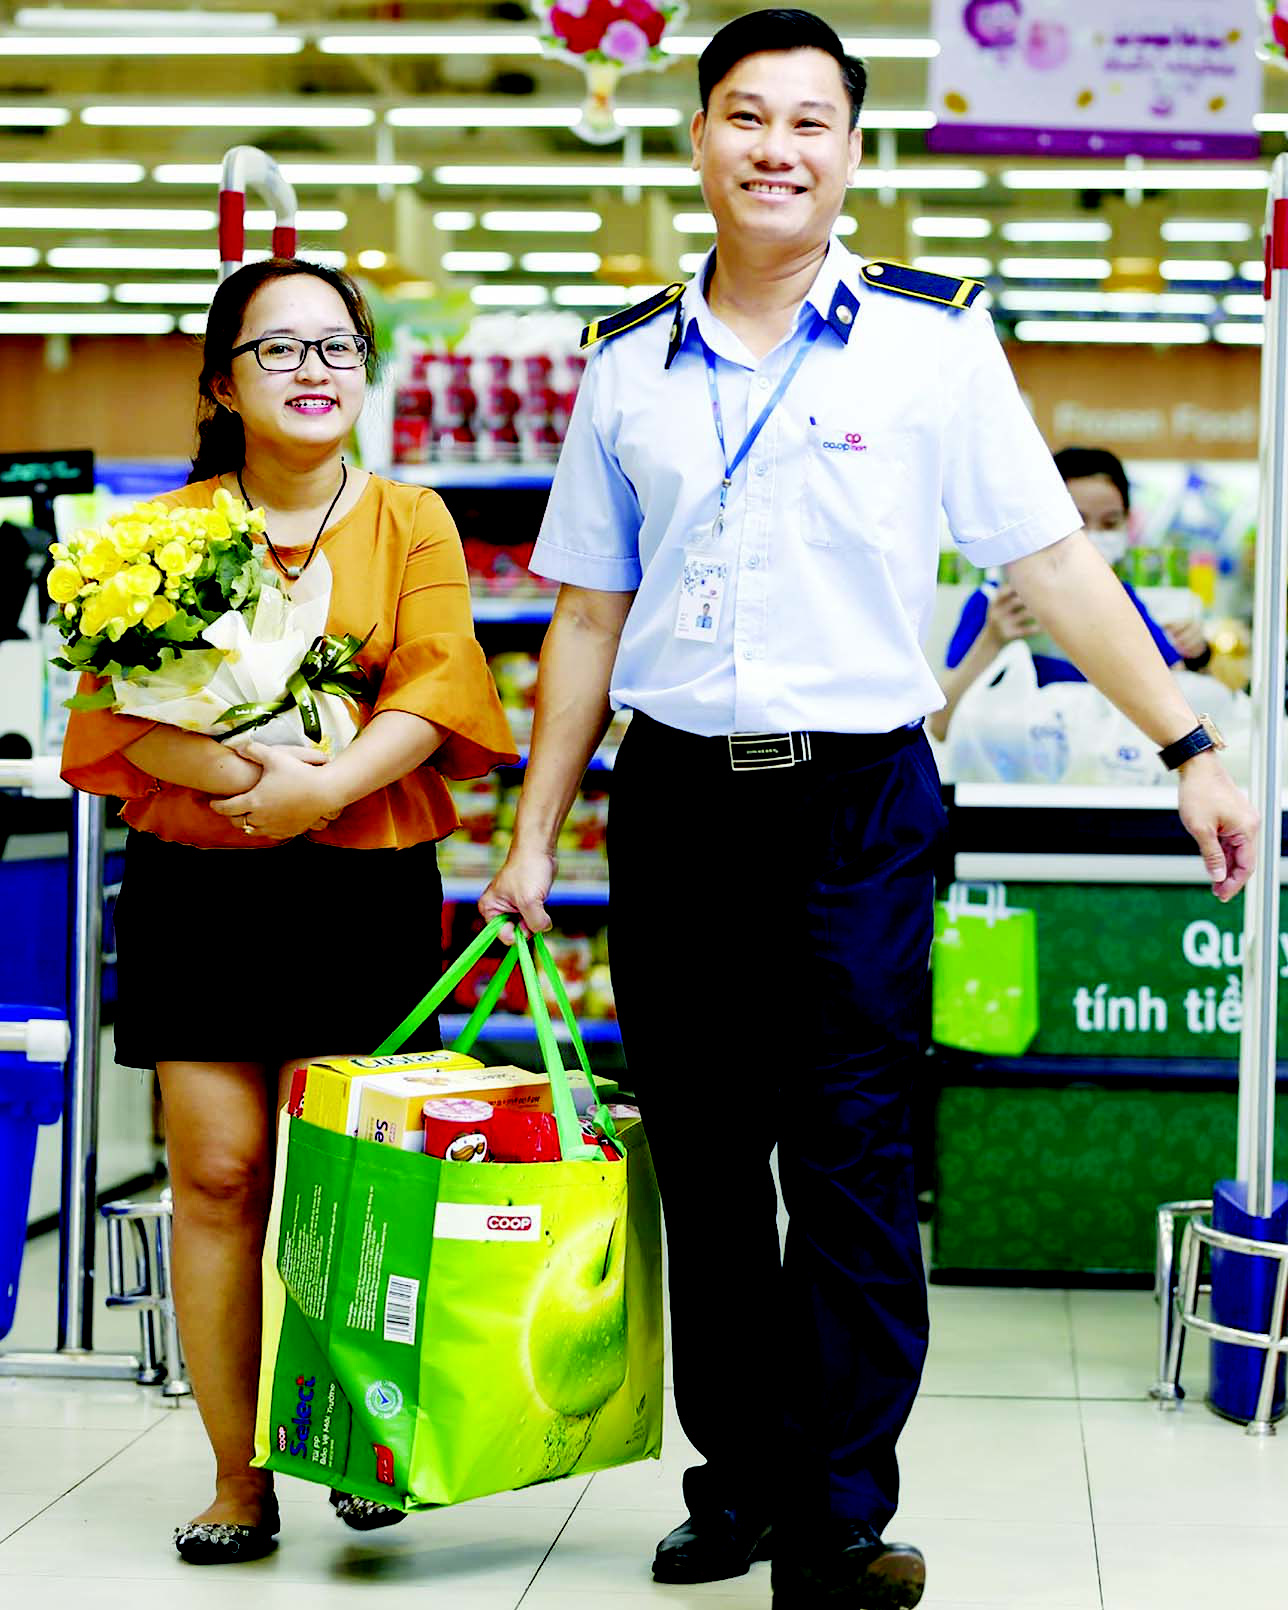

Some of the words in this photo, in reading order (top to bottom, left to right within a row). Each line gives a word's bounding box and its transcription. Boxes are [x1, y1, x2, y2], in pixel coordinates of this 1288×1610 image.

[1073, 983, 1169, 1032] tính
[488, 1216, 531, 1230] COOP
[290, 1375, 316, 1459] Select
